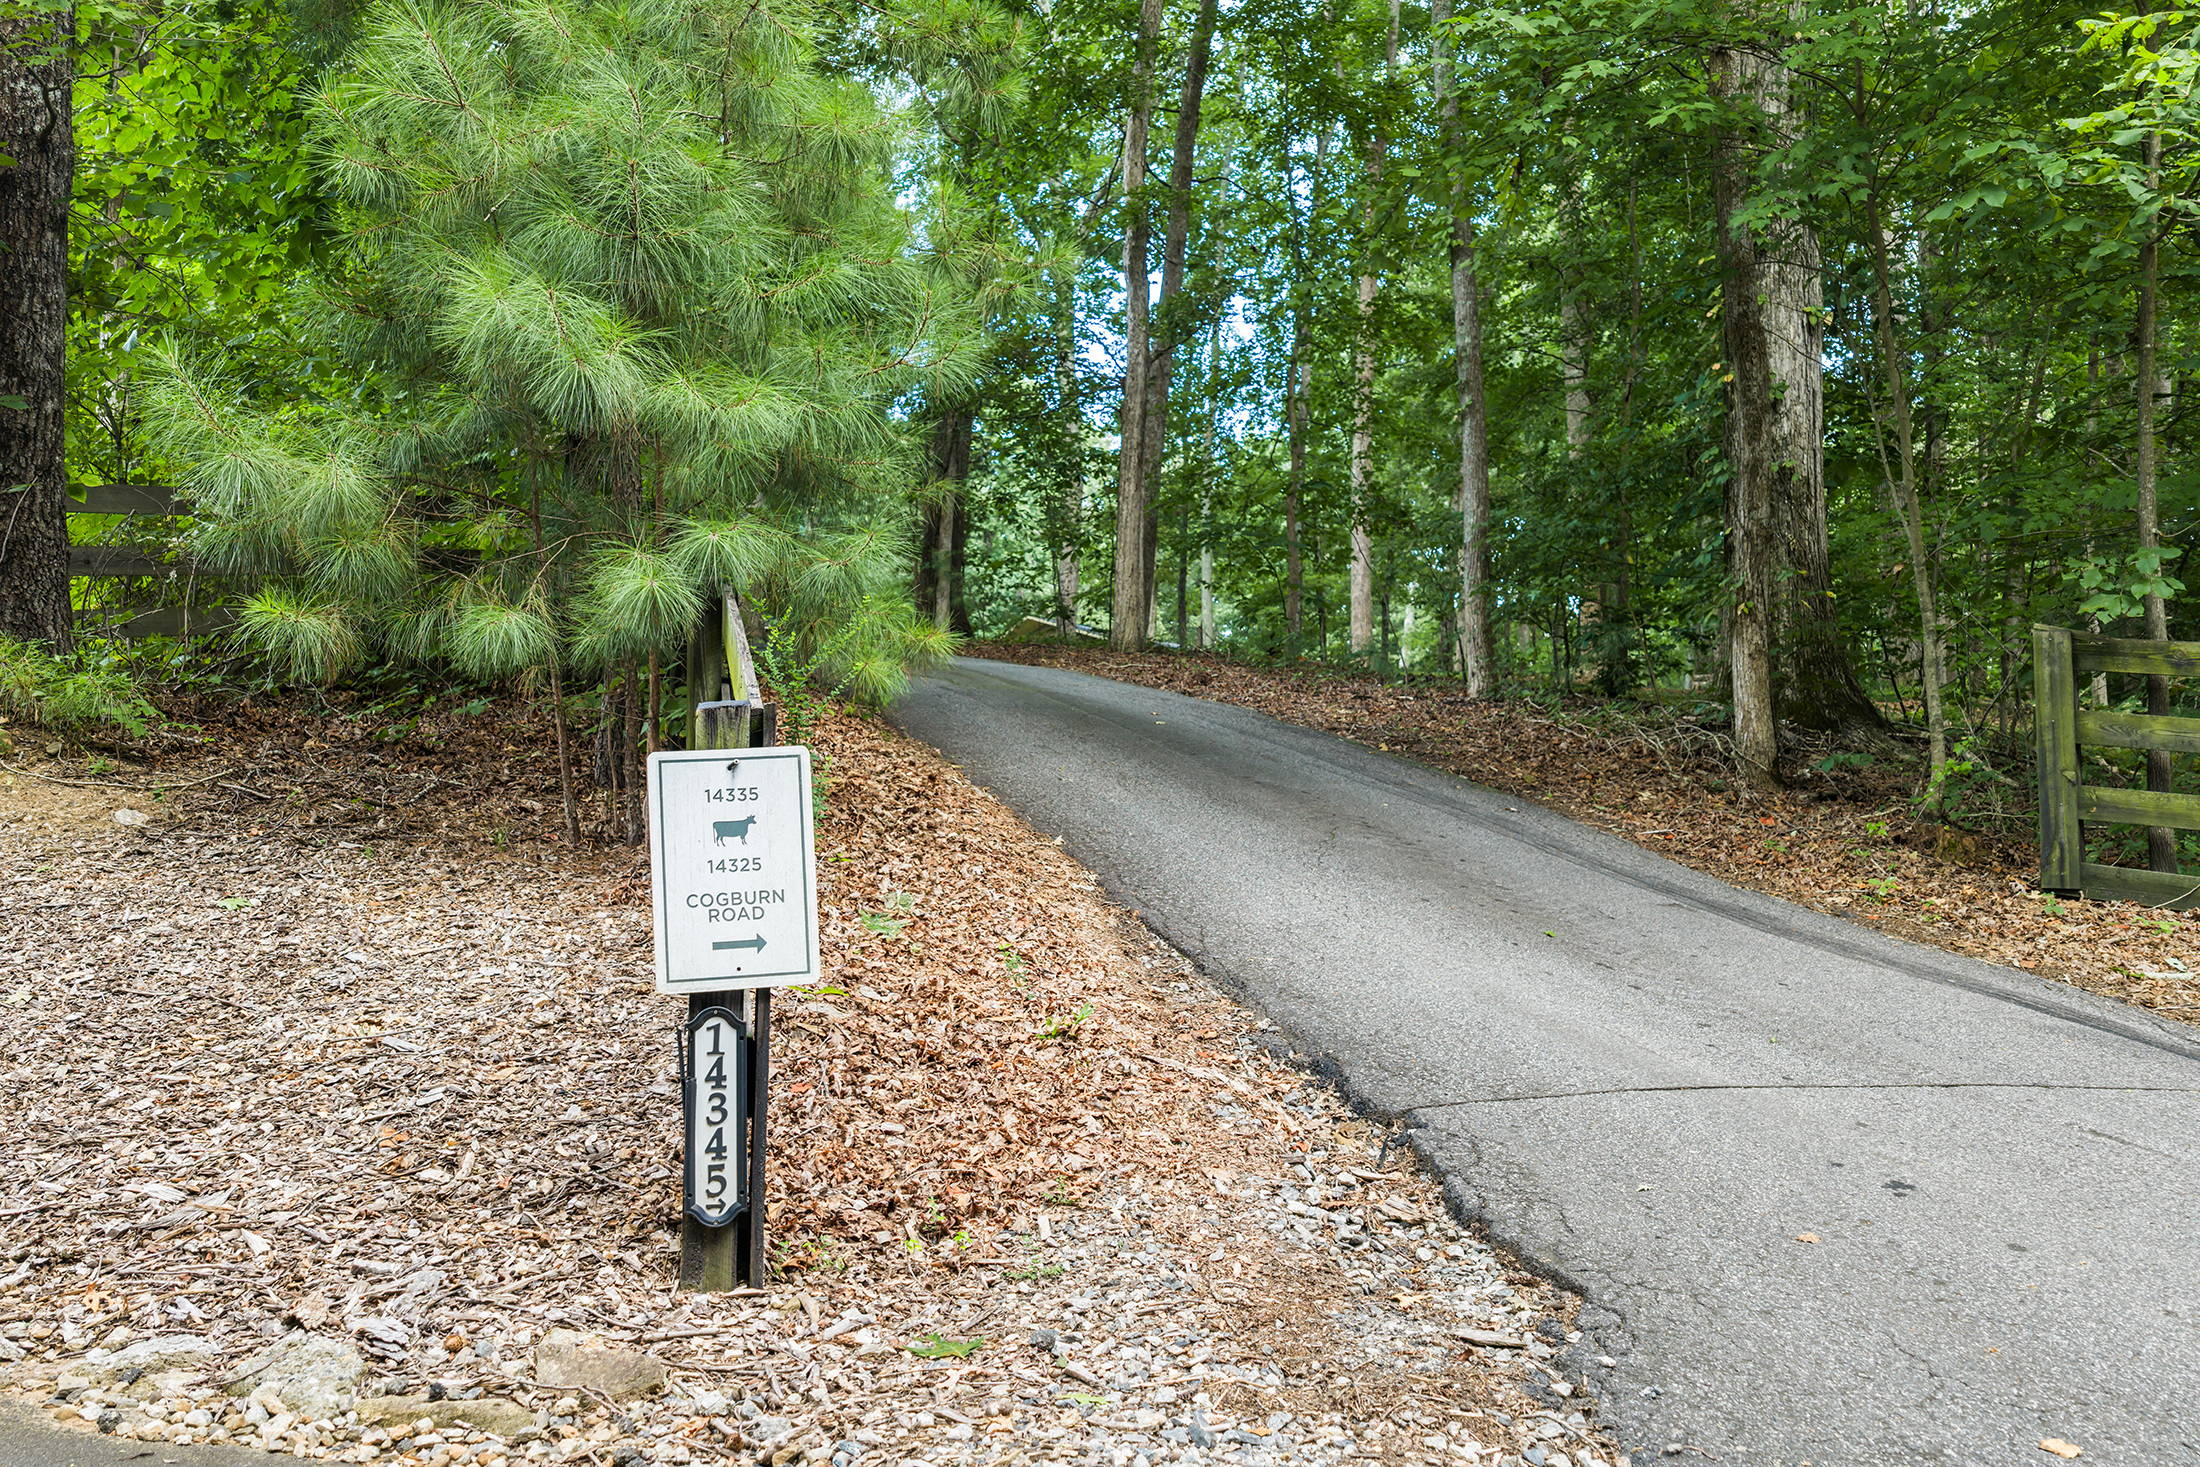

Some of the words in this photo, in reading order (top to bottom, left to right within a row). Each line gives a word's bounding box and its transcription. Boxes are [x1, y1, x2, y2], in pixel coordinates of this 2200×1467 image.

[704, 787, 759, 803] 14335
[707, 857, 762, 874] 14325
[686, 889, 785, 908] COGBURN
[708, 906, 765, 923] ROAD
[704, 1022, 728, 1198] 14345
